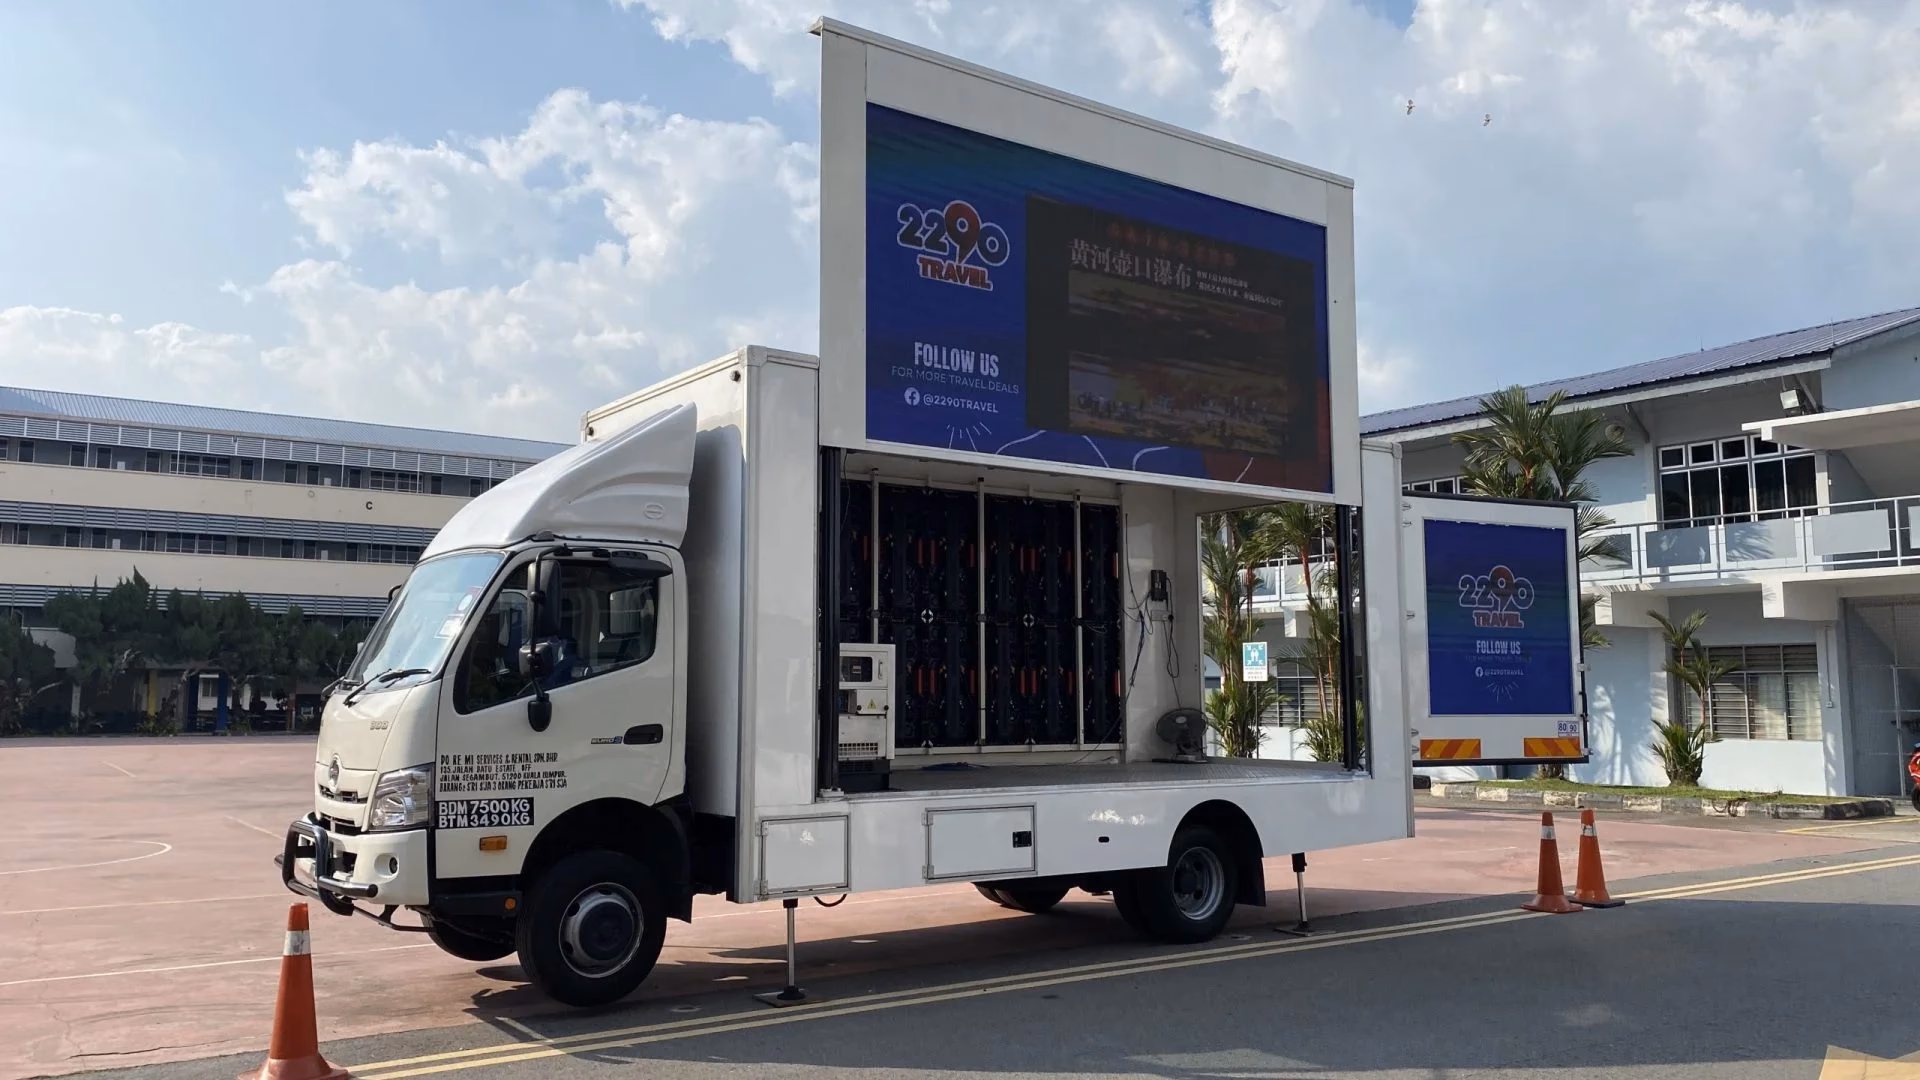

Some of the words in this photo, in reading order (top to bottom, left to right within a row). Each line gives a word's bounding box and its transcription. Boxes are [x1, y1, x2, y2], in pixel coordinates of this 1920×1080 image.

[897, 200, 1010, 266] 2290
[917, 254, 993, 291] TRAVEL
[914, 341, 975, 373] FOLLOW
[980, 353, 1000, 377] US
[892, 366, 913, 378] FOR
[916, 370, 946, 383] MORE
[950, 375, 986, 389] TRAVEL
[989, 381, 1019, 394] DEALS
[923, 394, 999, 413] @2290TRAVEL
[365, 501, 373, 510] C
[1459, 565, 1534, 609] 2290
[1473, 610, 1524, 628] TRAVEL
[1476, 640, 1508, 654] FOLLOW
[1511, 641, 1521, 655] US
[465, 755, 473, 765] MI
[477, 754, 503, 765] SERVICES
[511, 753, 533, 763] RENTAL
[523, 771, 541, 779] KUALA
[439, 801, 468, 815] BDM
[439, 815, 468, 828] BTM
